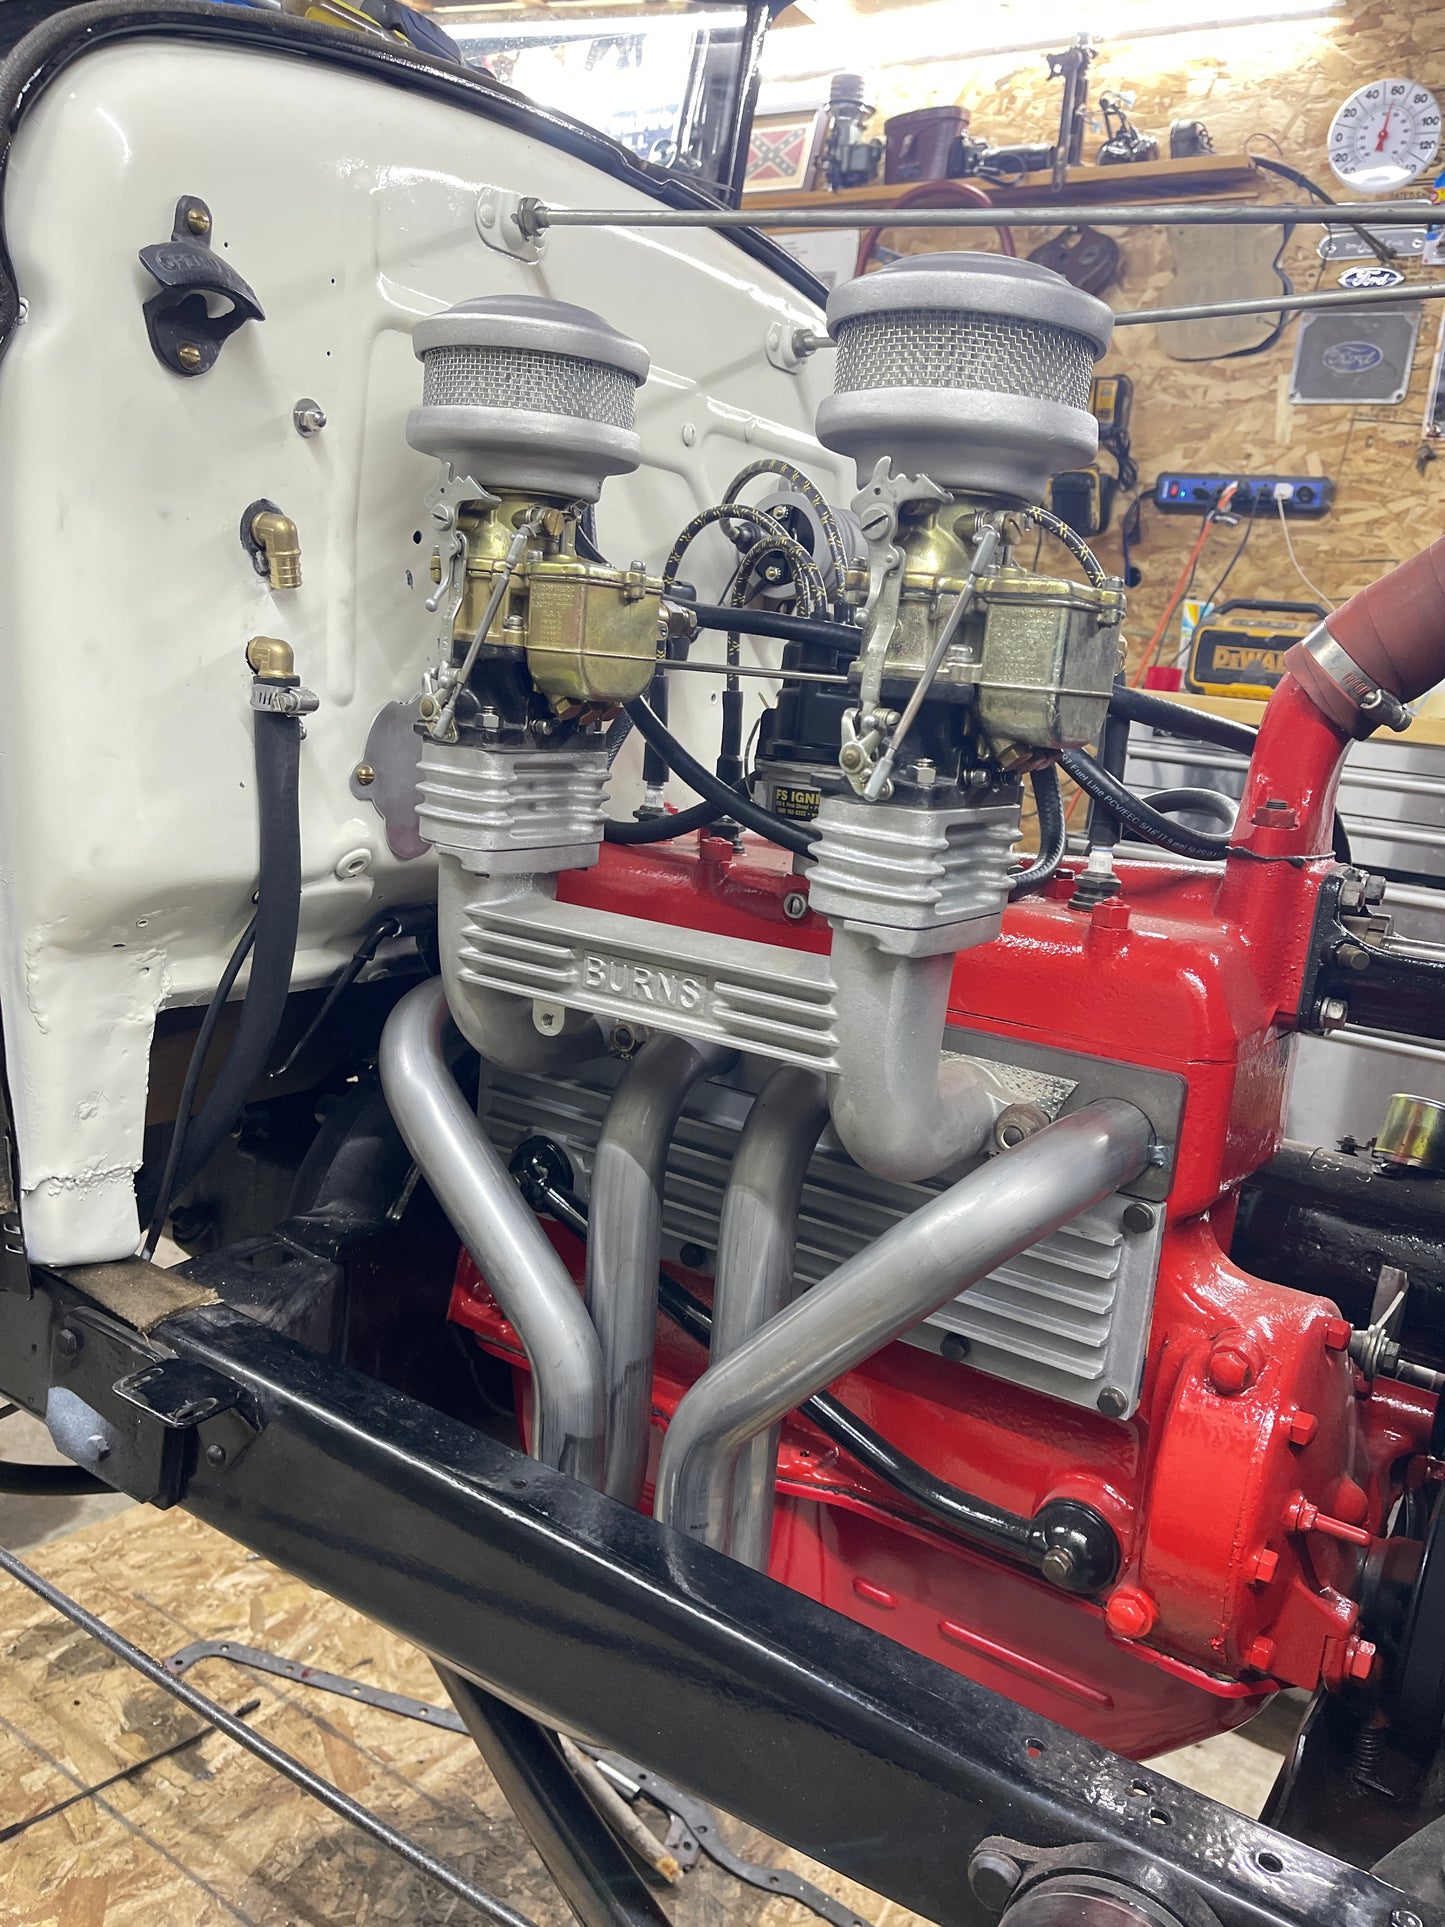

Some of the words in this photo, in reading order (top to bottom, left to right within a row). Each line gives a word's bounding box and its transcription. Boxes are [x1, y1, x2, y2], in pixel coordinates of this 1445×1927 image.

[1366, 90, 1380, 99] 40
[1391, 86, 1404, 96] 60
[1414, 94, 1428, 104] 80
[1343, 108, 1358, 118] 20
[1422, 116, 1440, 126] 100
[1336, 133, 1343, 142] 0
[1420, 141, 1436, 150] 120
[1352, 270, 1390, 286] Ford
[1327, 346, 1377, 366] Ford
[1213, 645, 1287, 674] DEWAL
[1062, 754, 1072, 764] R7
[1070, 764, 1088, 782] Fuel
[1087, 780, 1105, 796] Line
[1104, 794, 1140, 824] PCV/EEC
[776, 789, 788, 800] FS
[791, 791, 819, 804] IGNI
[587, 956, 703, 1008] BURNS
